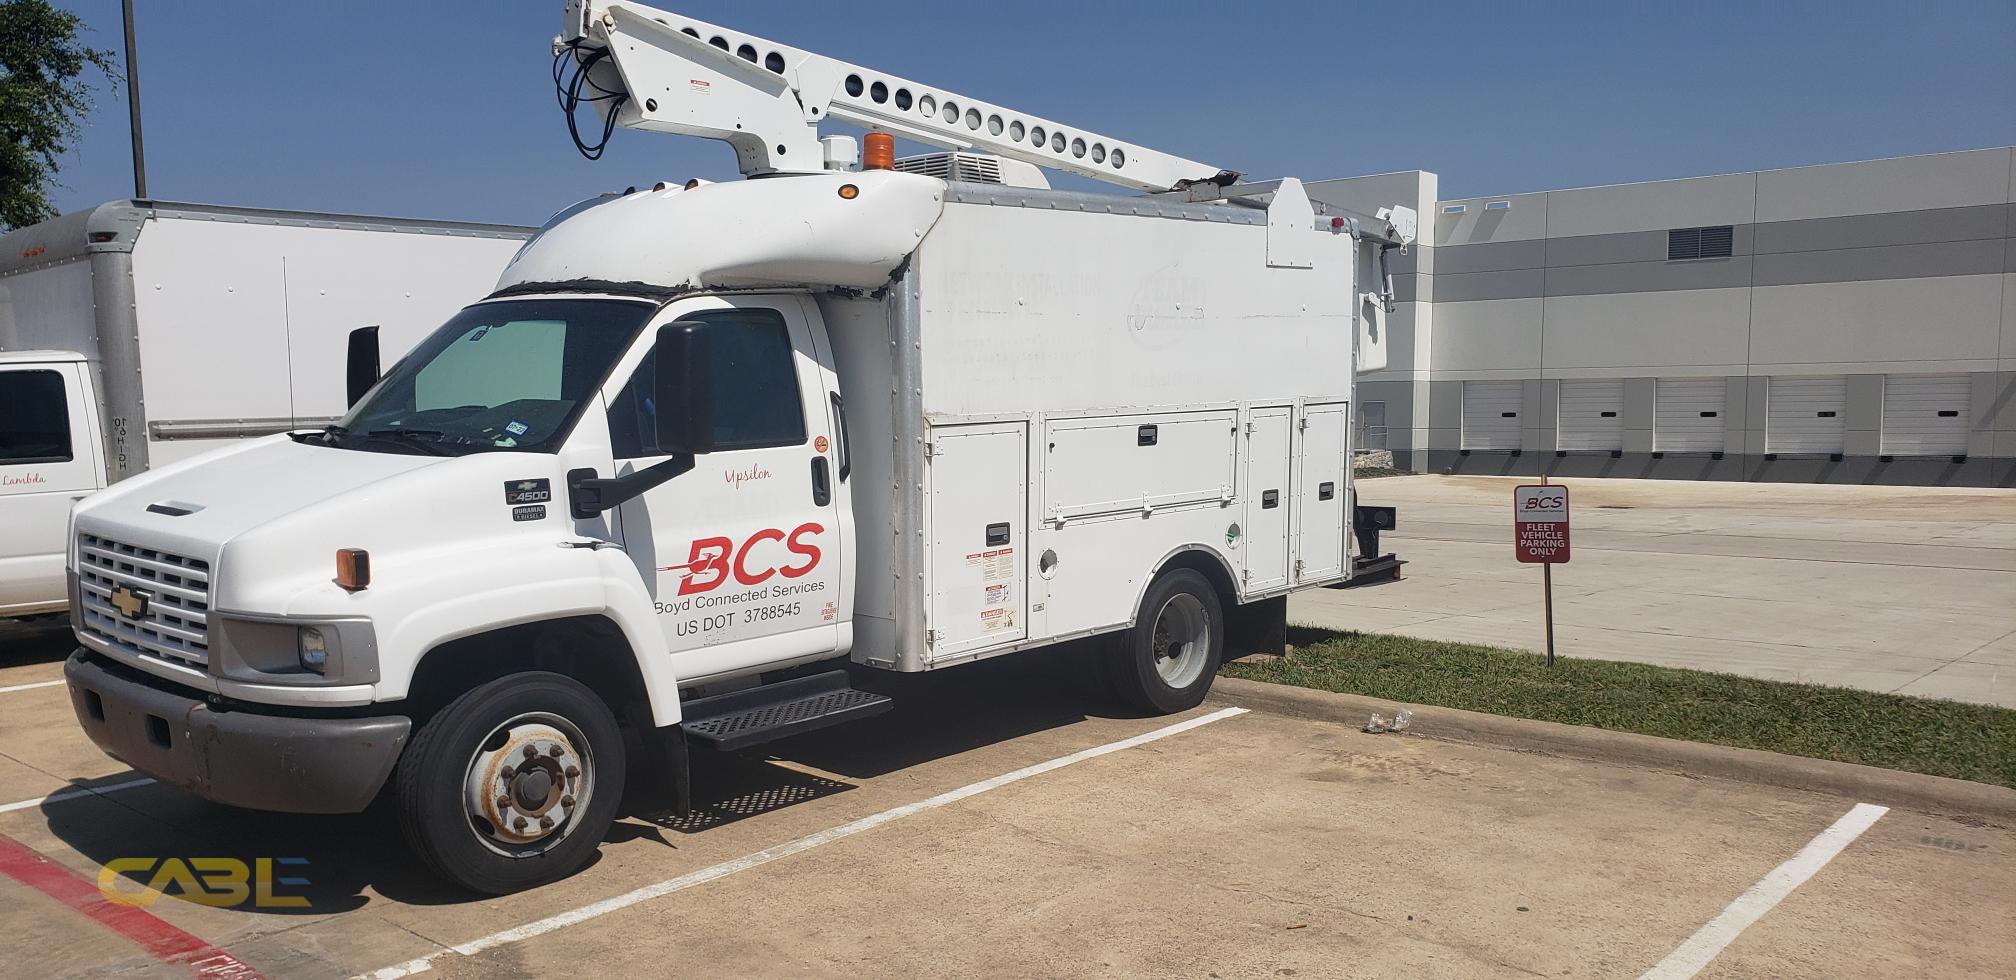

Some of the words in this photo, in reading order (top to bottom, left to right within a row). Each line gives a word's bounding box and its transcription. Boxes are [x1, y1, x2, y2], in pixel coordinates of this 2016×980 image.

[3, 472, 47, 485] Lambda
[725, 463, 772, 490] Upsilon
[514, 506, 545, 515] DURAMAX
[1525, 497, 1563, 509] BCS
[1526, 523, 1555, 531] FLEET
[677, 522, 825, 596] BCS
[654, 598, 690, 616] Boyd
[695, 587, 768, 609] Connected
[772, 580, 825, 598] Services
[677, 619, 698, 637] US
[703, 612, 735, 632] DOT
[744, 602, 801, 624] 3788545
